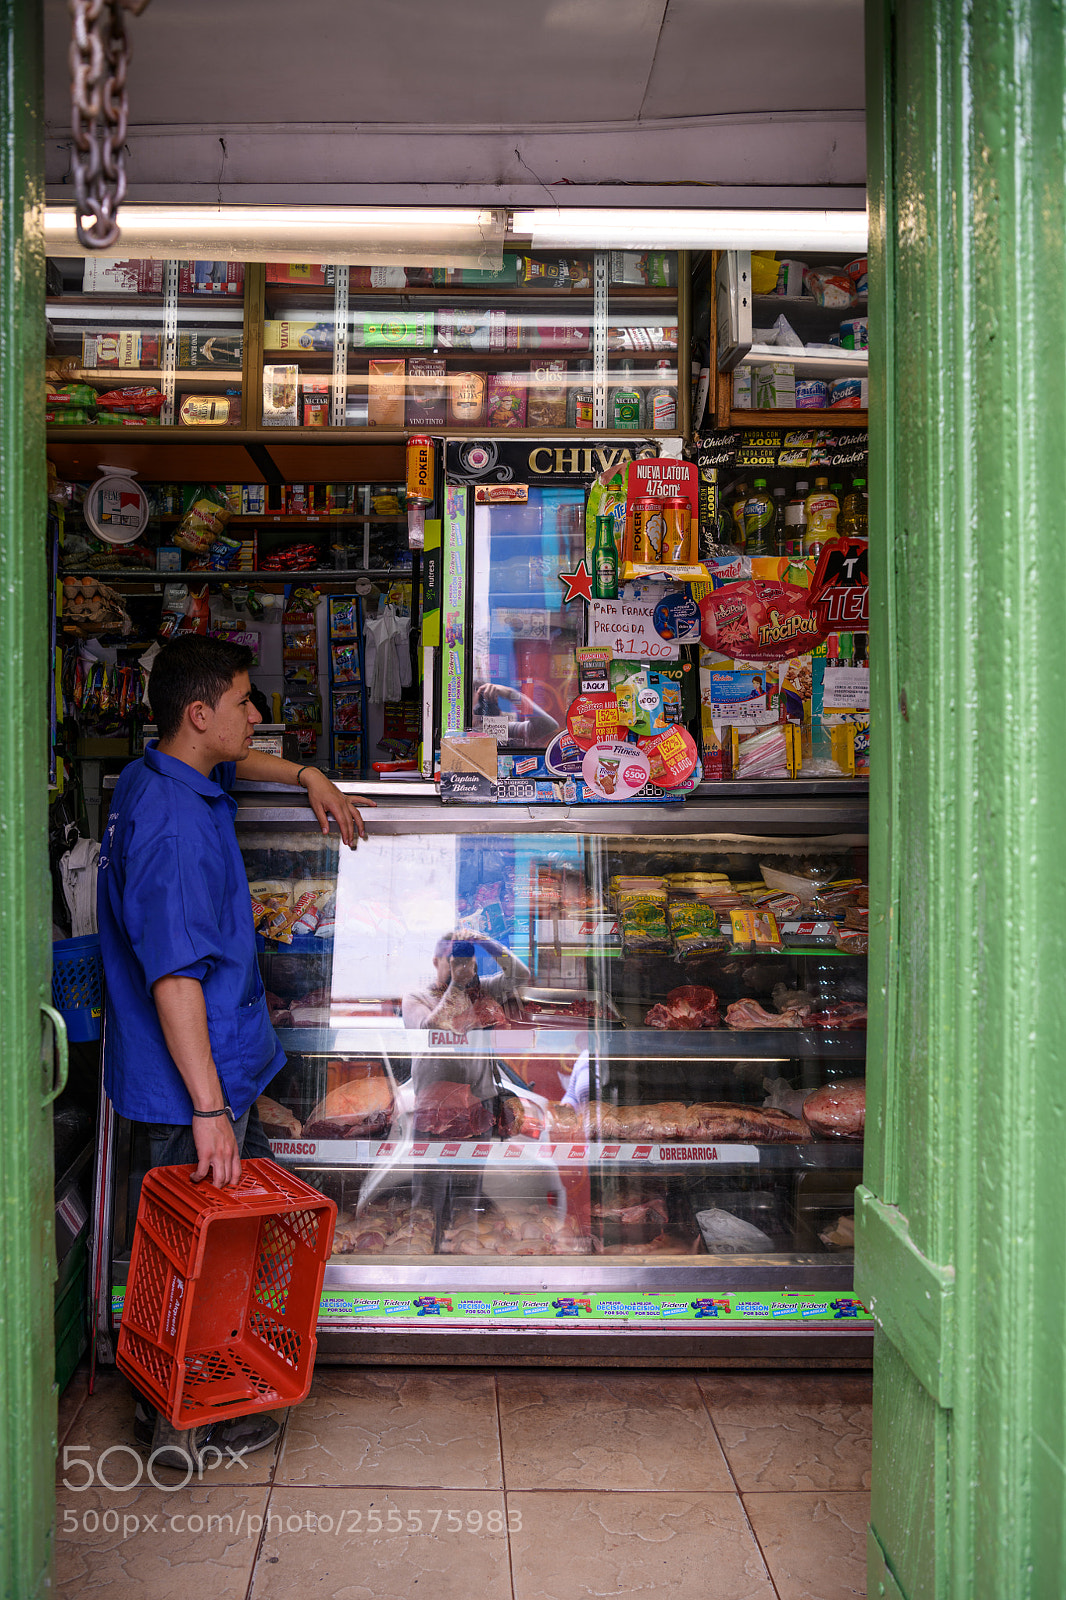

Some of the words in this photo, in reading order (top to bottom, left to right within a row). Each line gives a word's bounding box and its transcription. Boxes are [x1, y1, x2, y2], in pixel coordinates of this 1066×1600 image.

[280, 322, 288, 348] UVITA
[124, 333, 132, 366] TERMIDOR
[535, 368, 562, 381] Clos
[831, 386, 854, 403] Scott
[703, 435, 735, 448] Chiclets
[749, 438, 782, 446] LOOK
[698, 453, 729, 466] Chiclets
[832, 452, 864, 465] Chiclets
[420, 450, 428, 486] POKER
[636, 465, 660, 480] NUEVA
[662, 466, 690, 480] LATOTA
[634, 512, 642, 551] POKER
[594, 601, 618, 616] PAPA
[594, 620, 644, 634] PRECOCIDA
[448, 651, 456, 676] Trident
[614, 746, 640, 756] Fitness
[450, 774, 480, 784] Captain
[624, 770, 646, 780] $500
[452, 783, 478, 792] Black
[432, 1032, 468, 1046] FALDA
[269, 1142, 316, 1154] URRASCO
[660, 1147, 718, 1160] OBREBARRIGA
